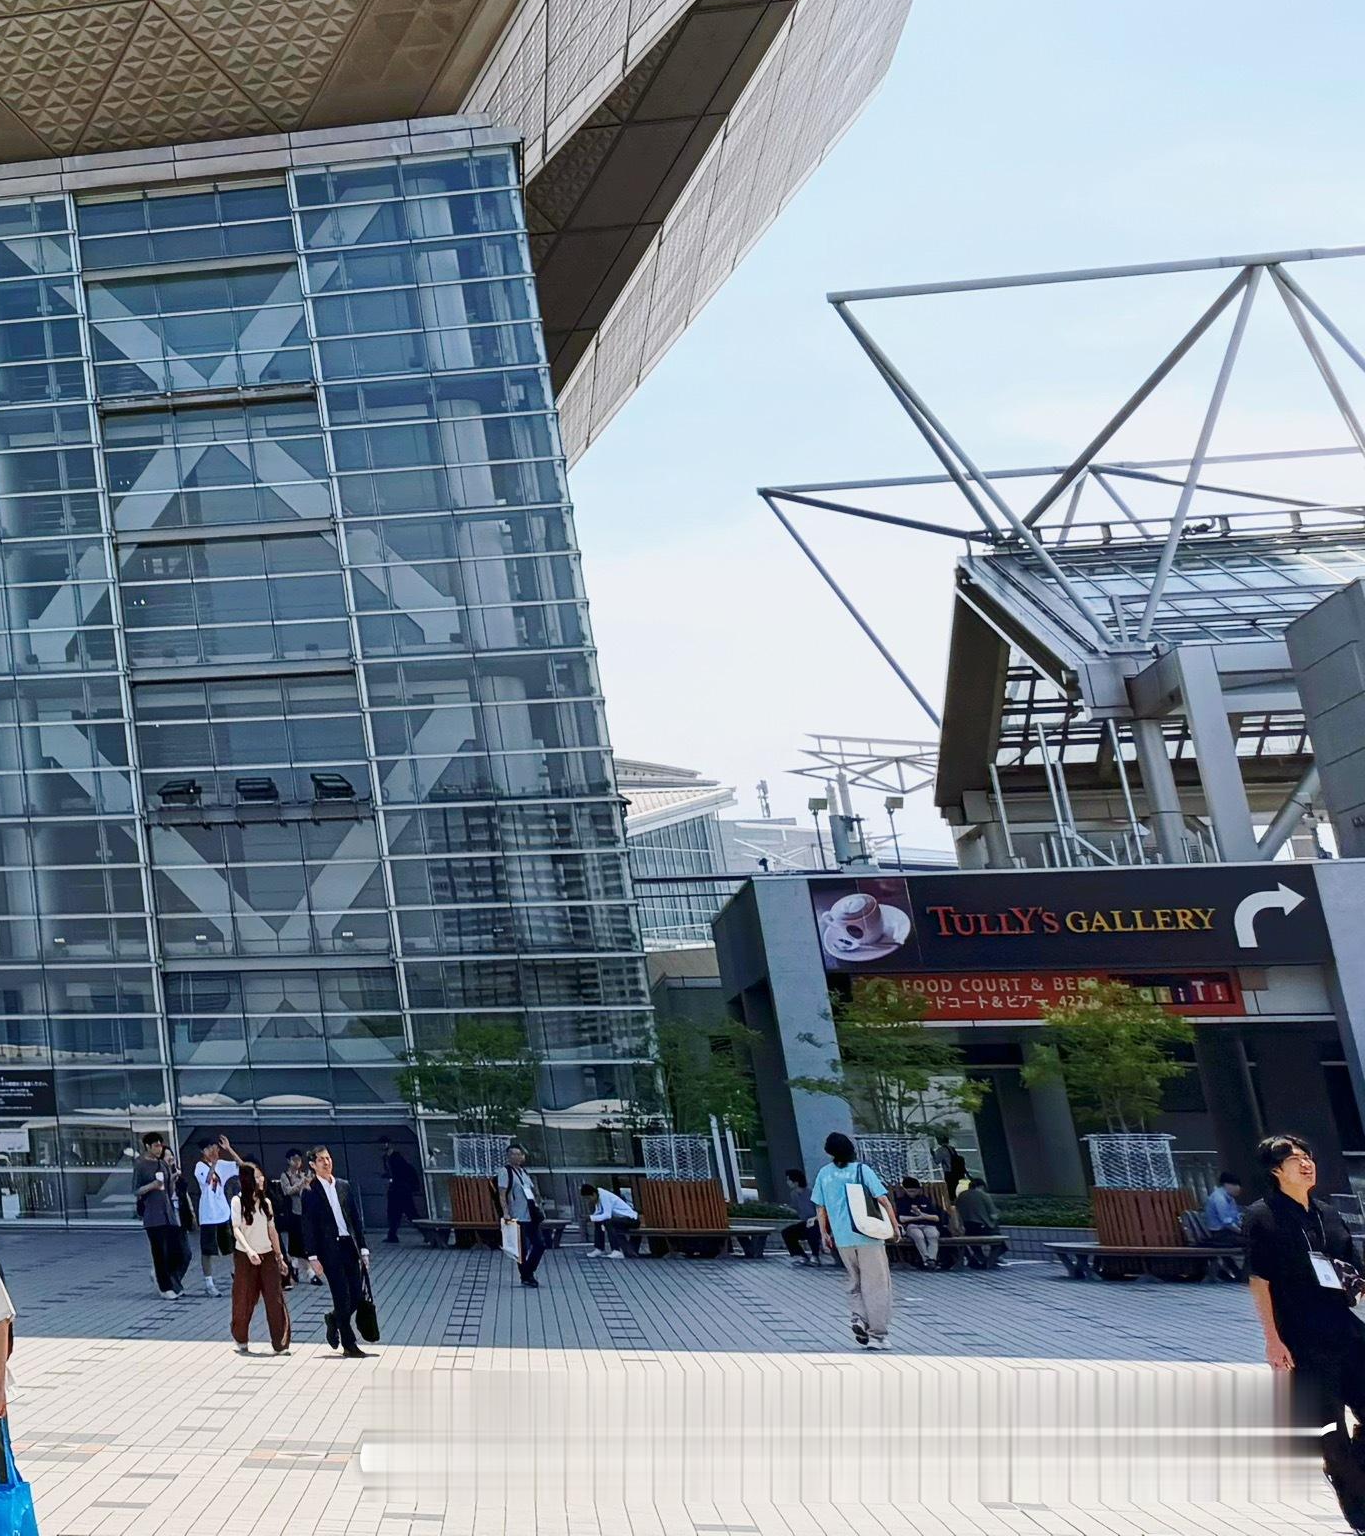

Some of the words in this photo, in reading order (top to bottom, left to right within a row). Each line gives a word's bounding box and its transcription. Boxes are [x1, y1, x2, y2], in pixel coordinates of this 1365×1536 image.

[1065, 907, 1218, 933] GALLERY
[902, 976, 953, 994] FOOD
[959, 976, 1021, 993] COURT
[1030, 975, 1045, 992] &
